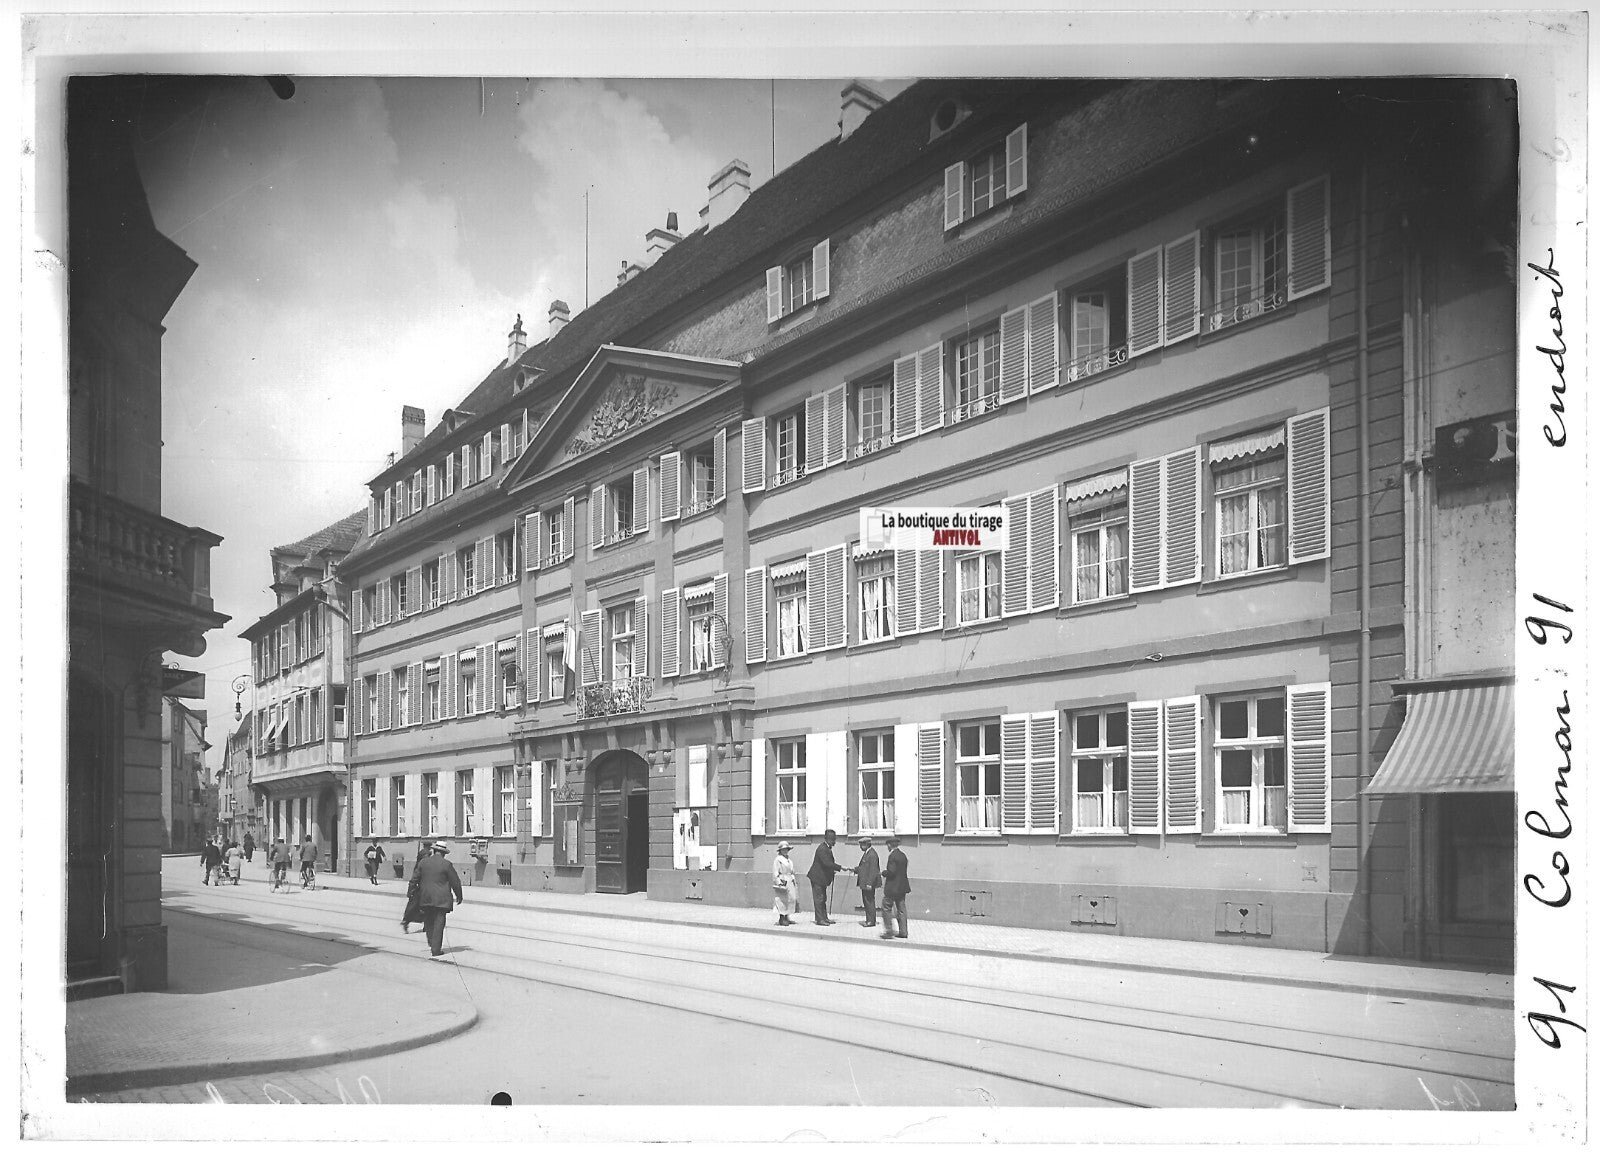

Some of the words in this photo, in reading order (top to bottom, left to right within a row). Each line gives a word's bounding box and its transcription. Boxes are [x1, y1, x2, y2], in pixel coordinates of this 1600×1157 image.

[1526, 247, 1568, 448] endroit
[1524, 593, 1574, 645] 91
[1524, 690, 1572, 908] Colmar
[1527, 976, 1587, 1049] 91
